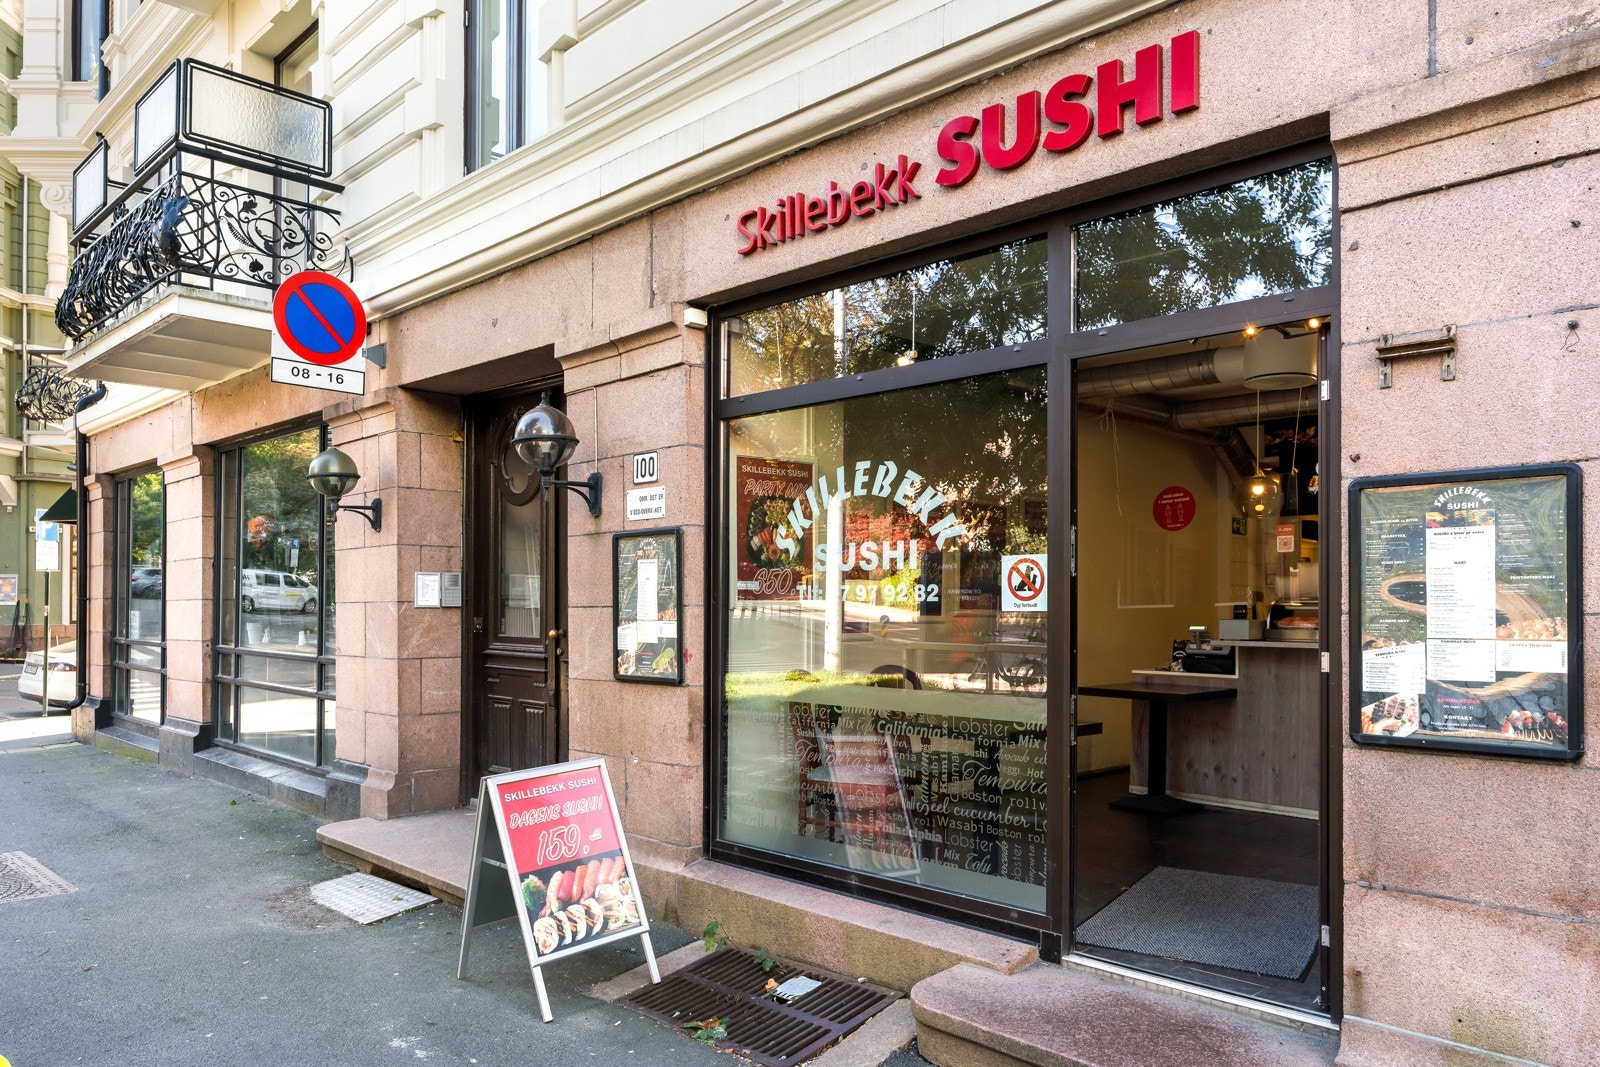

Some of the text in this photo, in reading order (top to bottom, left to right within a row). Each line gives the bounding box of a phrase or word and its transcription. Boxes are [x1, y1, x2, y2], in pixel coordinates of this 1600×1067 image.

[737, 30, 1201, 256] Skillebekk SUSHI
[291, 366, 310, 379] 08
[327, 372, 344, 385] 16
[636, 456, 655, 479] 100
[741, 465, 809, 478] SKILLEBEKK SUSHI
[744, 478, 785, 497] PARTY
[1433, 486, 1492, 508] SKILLEBEKK
[775, 460, 966, 560] SKILLEBEKK
[1447, 501, 1479, 510] SUSHI
[815, 540, 918, 572] SUSHI
[855, 585, 879, 602] 97
[885, 584, 908, 601] 92
[914, 584, 939, 602] 82
[797, 729, 815, 738] Sushi
[877, 719, 942, 739] California
[952, 715, 1009, 737] Lobster
[1018, 735, 1041, 749] Mix
[964, 747, 988, 759] Sushi
[993, 749, 1030, 762] Avocado
[962, 760, 1047, 795] Tempura
[1027, 767, 1045, 779] Hot
[504, 776, 597, 803] SKILLEBEKK SUSHI
[961, 786, 1037, 810] Boston roll
[509, 805, 561, 830] DAGENS
[931, 797, 951, 815] eel
[953, 805, 1031, 828] cucumber
[875, 820, 943, 843] Philadelphia
[937, 814, 984, 834] Wasabi
[986, 824, 1022, 840] Boston
[944, 828, 994, 852] Lobster
[944, 848, 961, 861] Mix
[1011, 843, 1022, 881] obster
